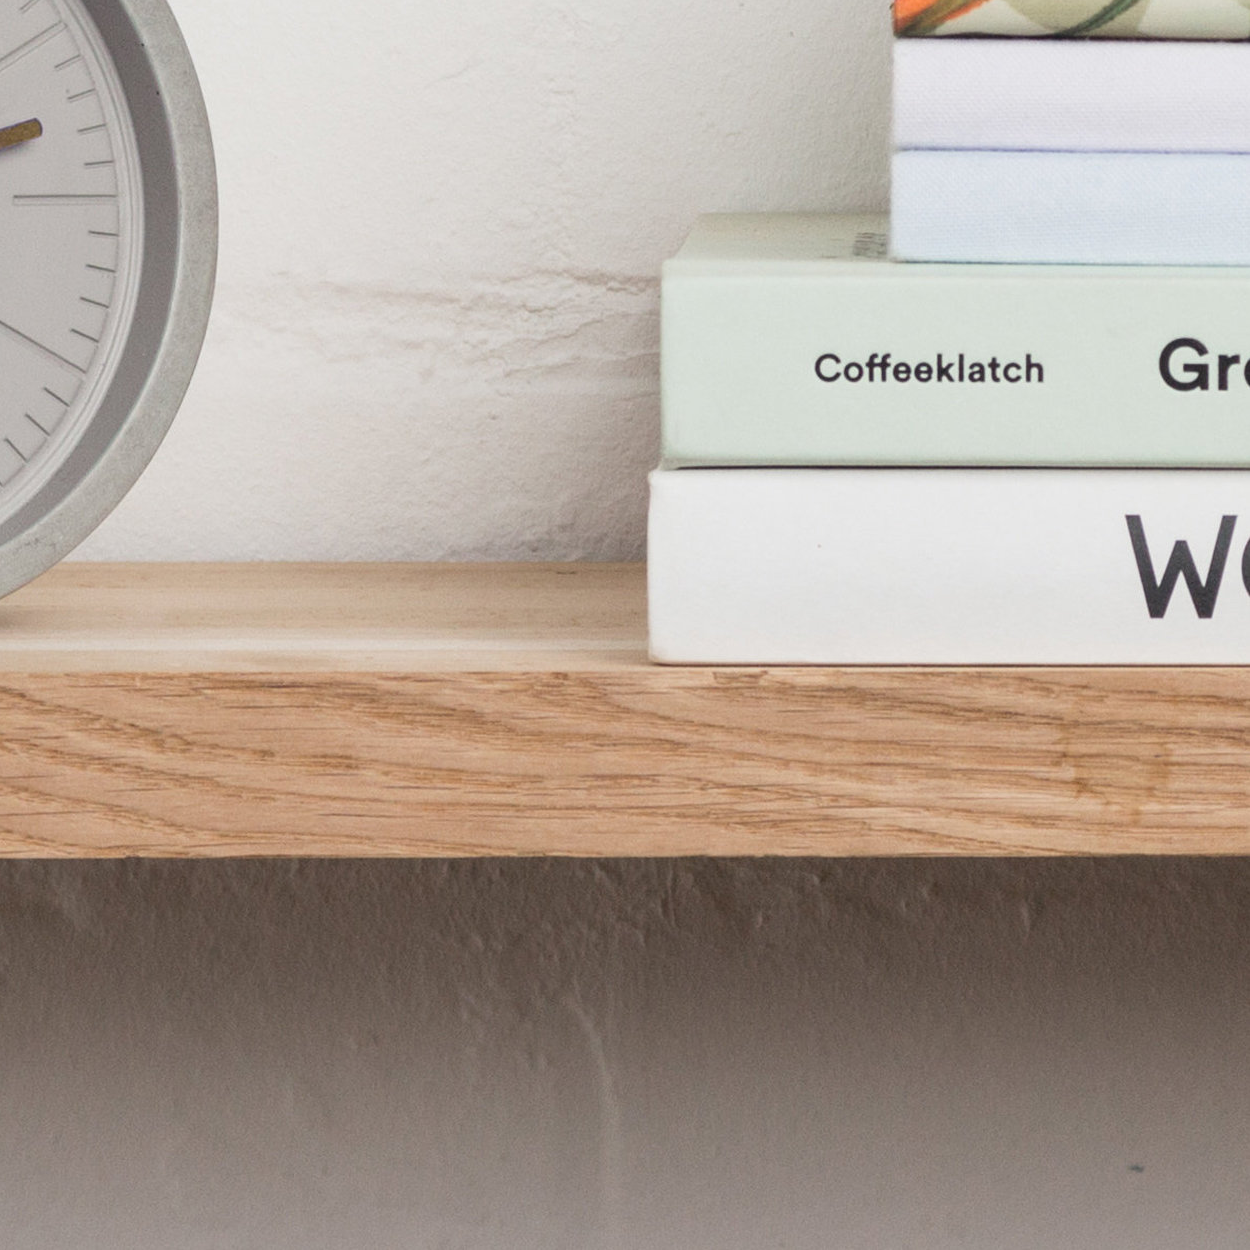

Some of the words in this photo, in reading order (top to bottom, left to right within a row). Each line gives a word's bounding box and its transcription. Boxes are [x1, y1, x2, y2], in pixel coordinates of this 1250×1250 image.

[814, 353, 1044, 383] Coffeeklatch
[1158, 337, 1250, 392] Gr
[1125, 514, 1250, 619] W
